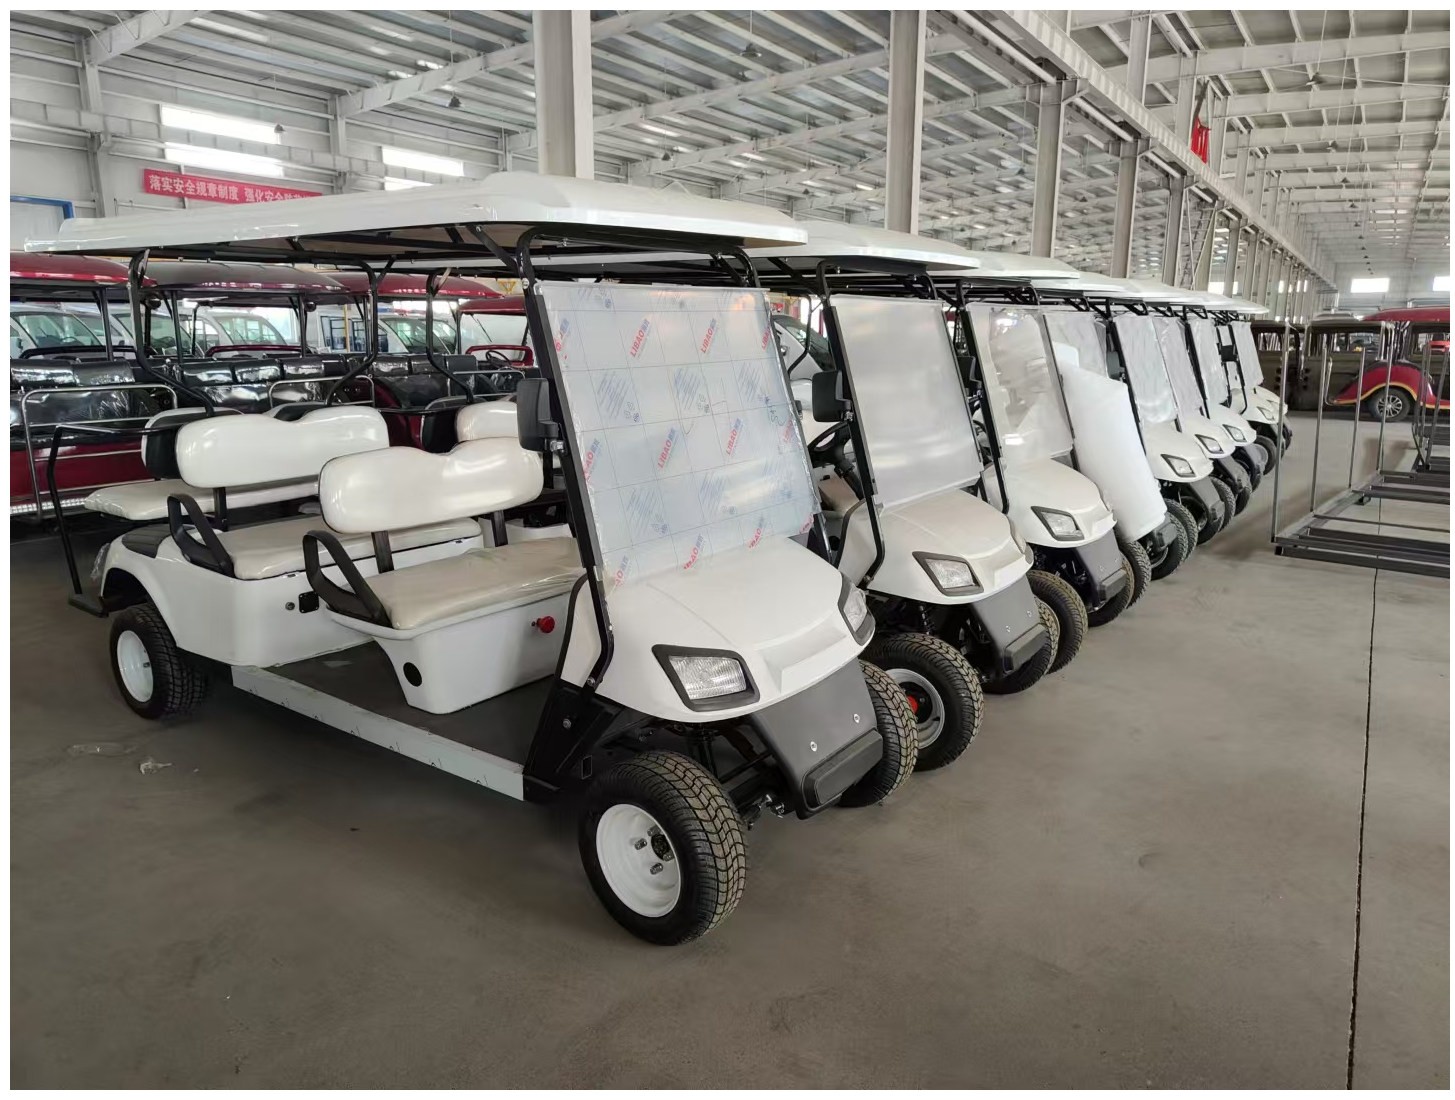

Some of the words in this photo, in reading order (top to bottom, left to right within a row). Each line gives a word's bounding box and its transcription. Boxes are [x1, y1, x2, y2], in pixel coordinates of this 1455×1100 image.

[149, 174, 239, 201] 落实安全规章制度
[630, 330, 645, 358] LIBAO
[701, 328, 713, 354] LIBAO
[658, 440, 672, 469] LIBAO
[726, 429, 738, 456] LIBAO
